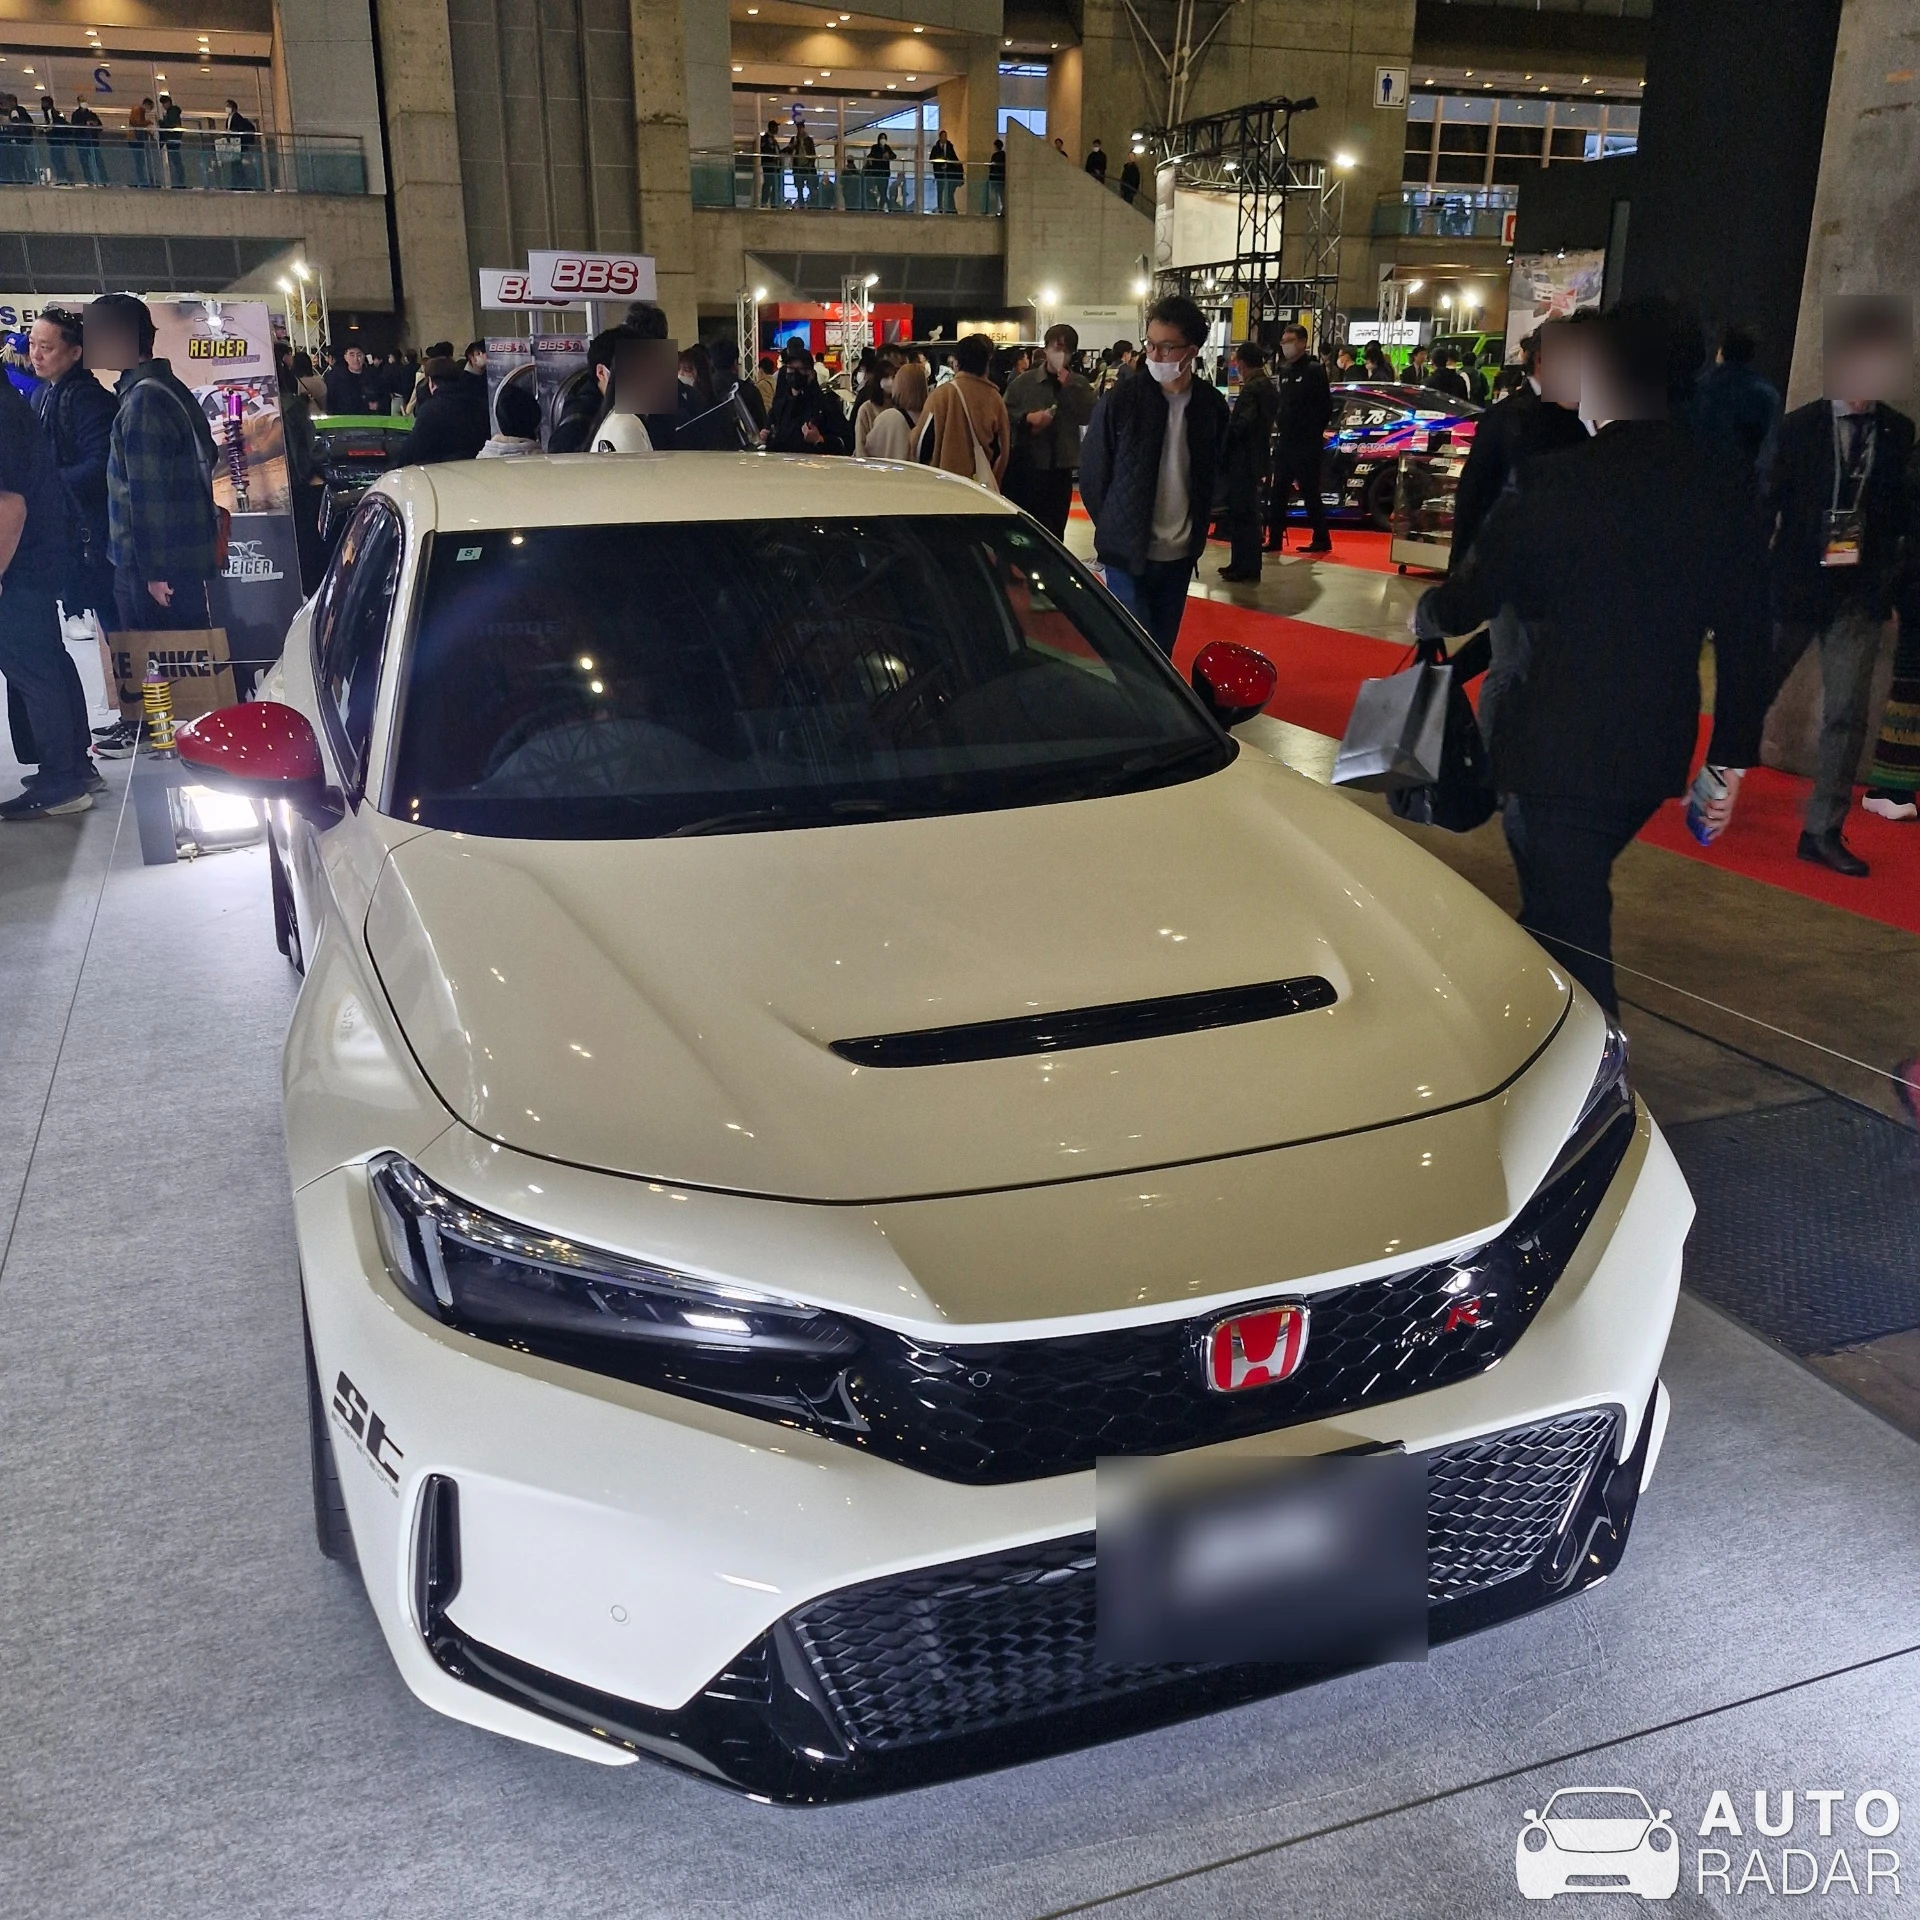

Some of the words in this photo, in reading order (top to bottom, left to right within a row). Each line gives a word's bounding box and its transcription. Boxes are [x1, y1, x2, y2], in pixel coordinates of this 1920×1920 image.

[551, 258, 639, 294] BBS
[189, 339, 247, 358] REIGER
[488, 343, 512, 352] BBS
[538, 340, 566, 351] BBS
[1364, 410, 1386, 424] 78
[148, 650, 211, 677] NIKE
